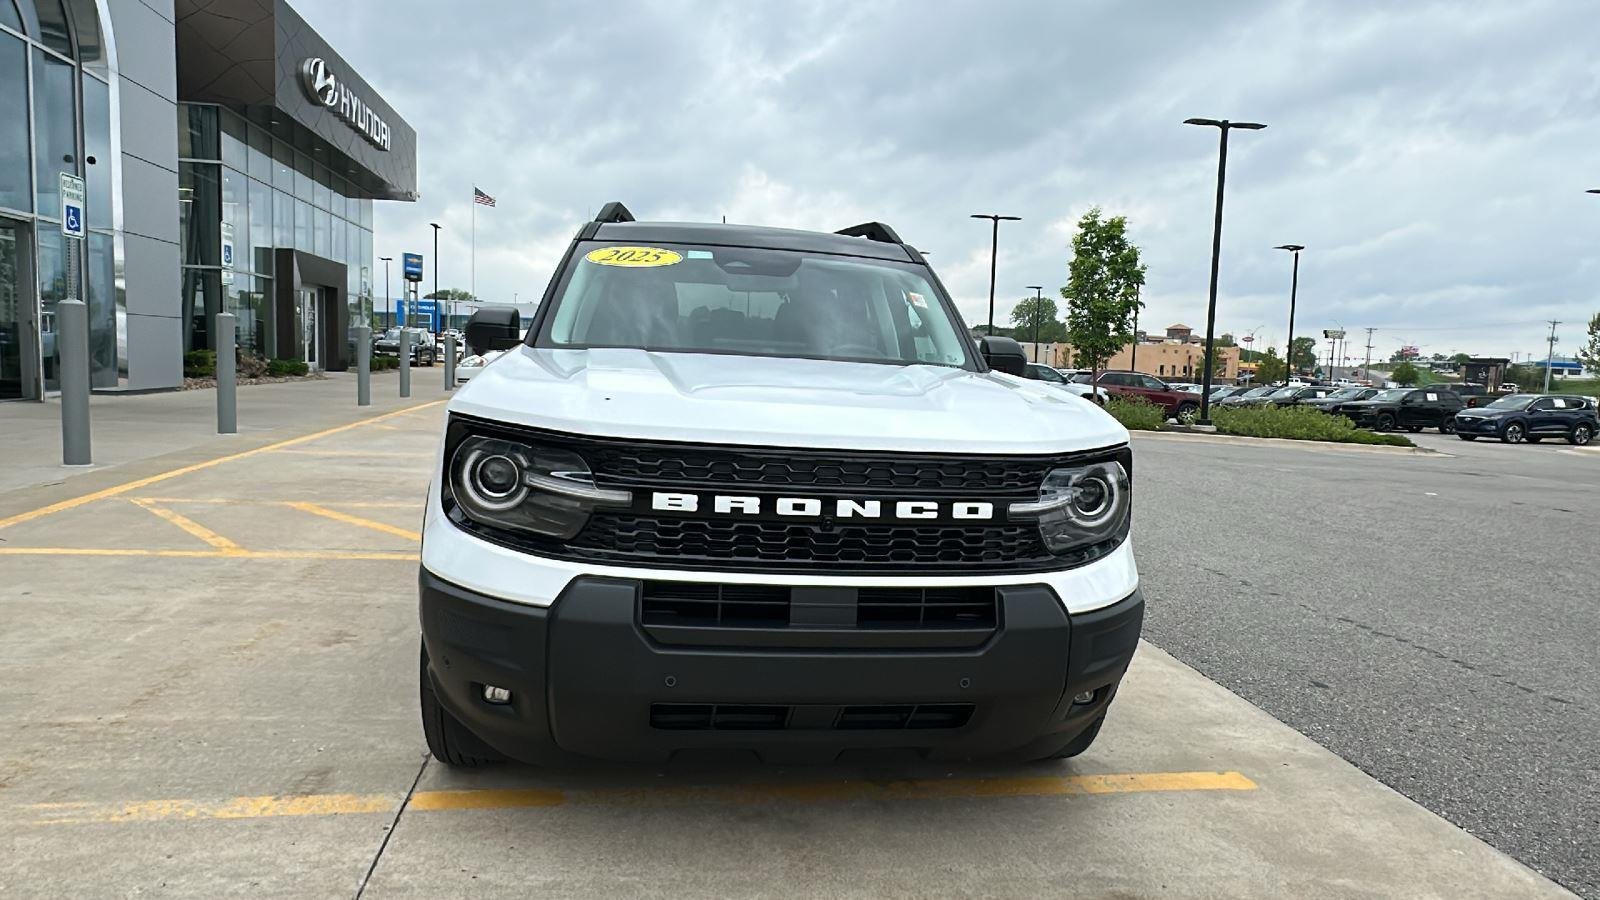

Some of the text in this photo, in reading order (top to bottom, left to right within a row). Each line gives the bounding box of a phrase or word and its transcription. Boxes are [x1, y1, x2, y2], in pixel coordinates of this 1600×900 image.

[341, 83, 391, 151] HYUNDAI
[63, 189, 83, 202] PARKING
[601, 249, 668, 262] 2025
[652, 492, 993, 519] BRONCO
